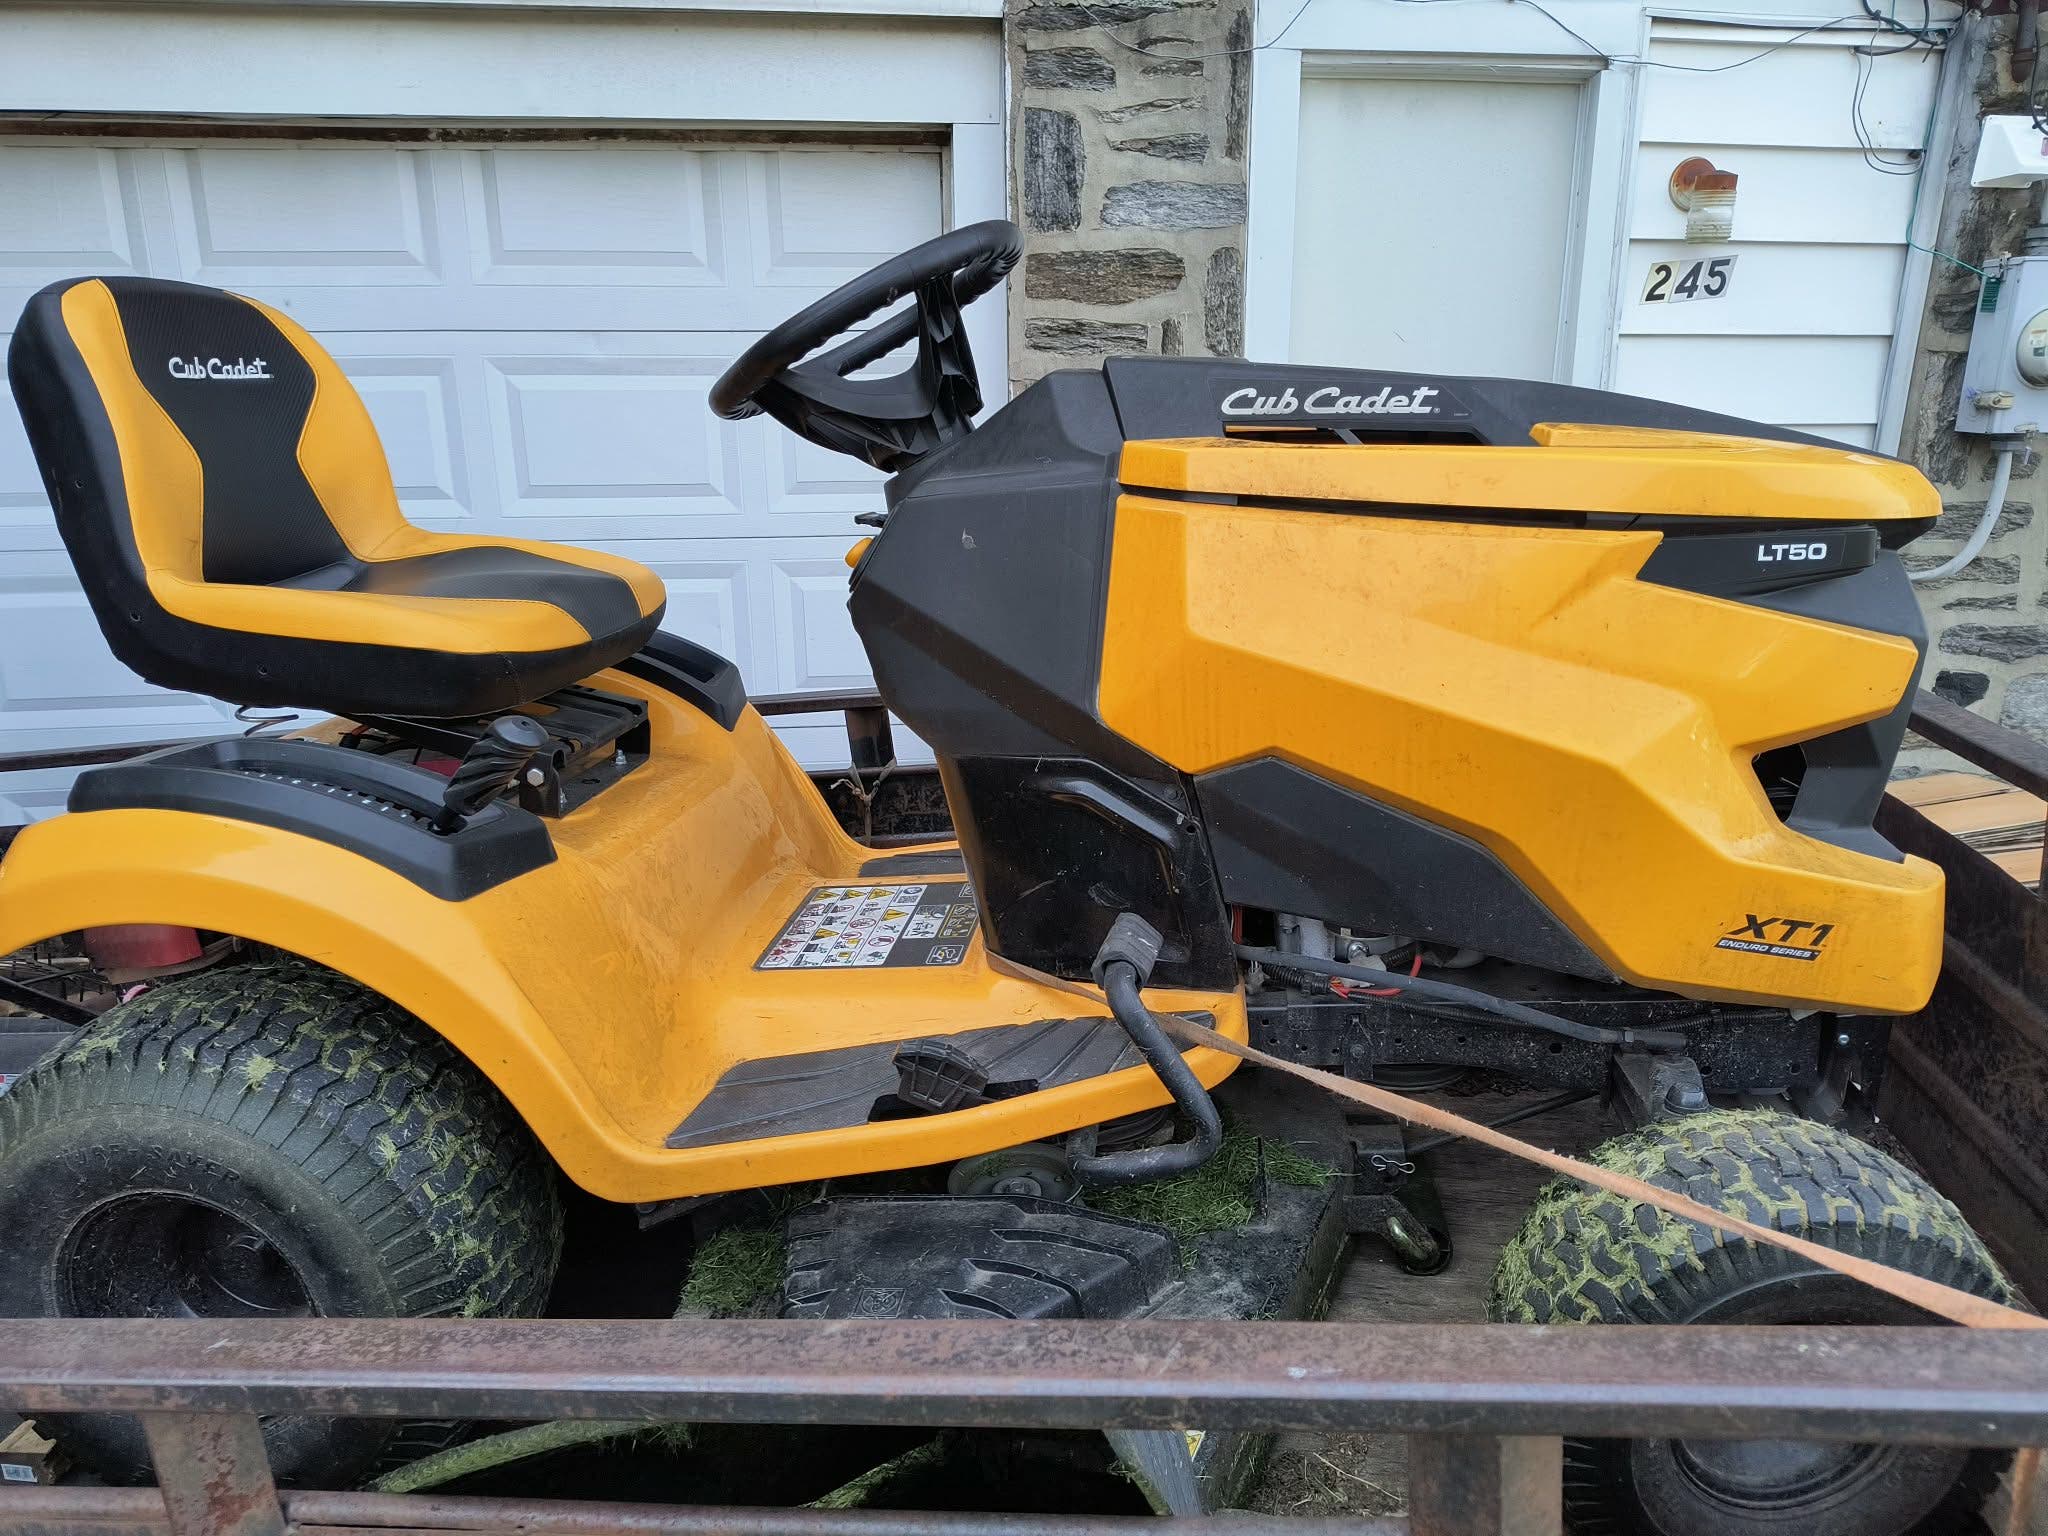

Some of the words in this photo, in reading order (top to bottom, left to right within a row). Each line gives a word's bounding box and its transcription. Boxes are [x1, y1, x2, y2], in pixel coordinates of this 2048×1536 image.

[1645, 258, 1732, 302] 245
[168, 356, 207, 379] Cub
[207, 357, 271, 379] Cadet
[1221, 387, 1299, 415] Cub
[1303, 386, 1439, 414] Cadet
[1757, 542, 1828, 562] LT50
[1725, 913, 1835, 947] XT1
[1718, 938, 1769, 953] ENDURO
[1770, 946, 1813, 959] SERIES
